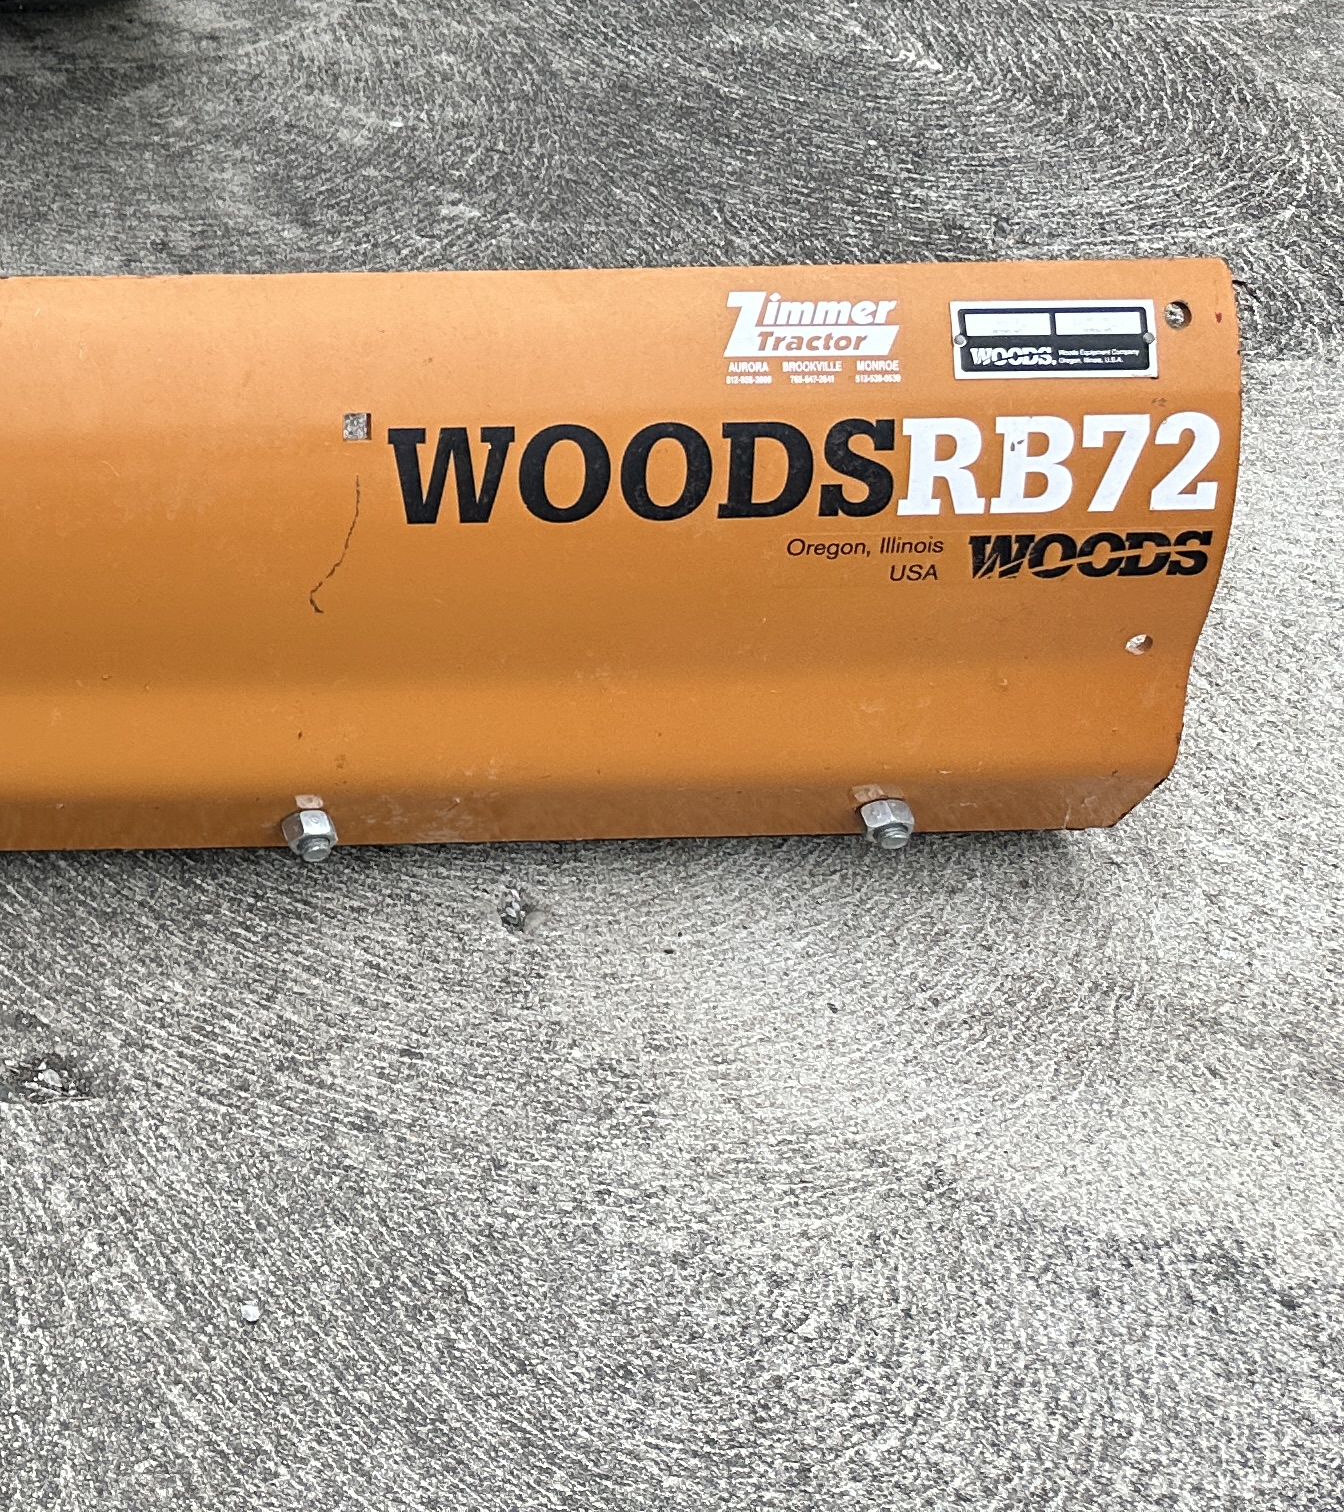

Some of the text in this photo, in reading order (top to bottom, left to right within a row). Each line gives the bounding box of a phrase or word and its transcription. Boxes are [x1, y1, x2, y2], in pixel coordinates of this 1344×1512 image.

[724, 291, 898, 352] Zimmer
[757, 331, 868, 351] Tractor
[728, 359, 900, 373] AURORA BROOKVILLE MONROE
[786, 536, 944, 557] Oregon, Illinois
[968, 529, 1212, 580] WOODS
[889, 564, 938, 582] USA
